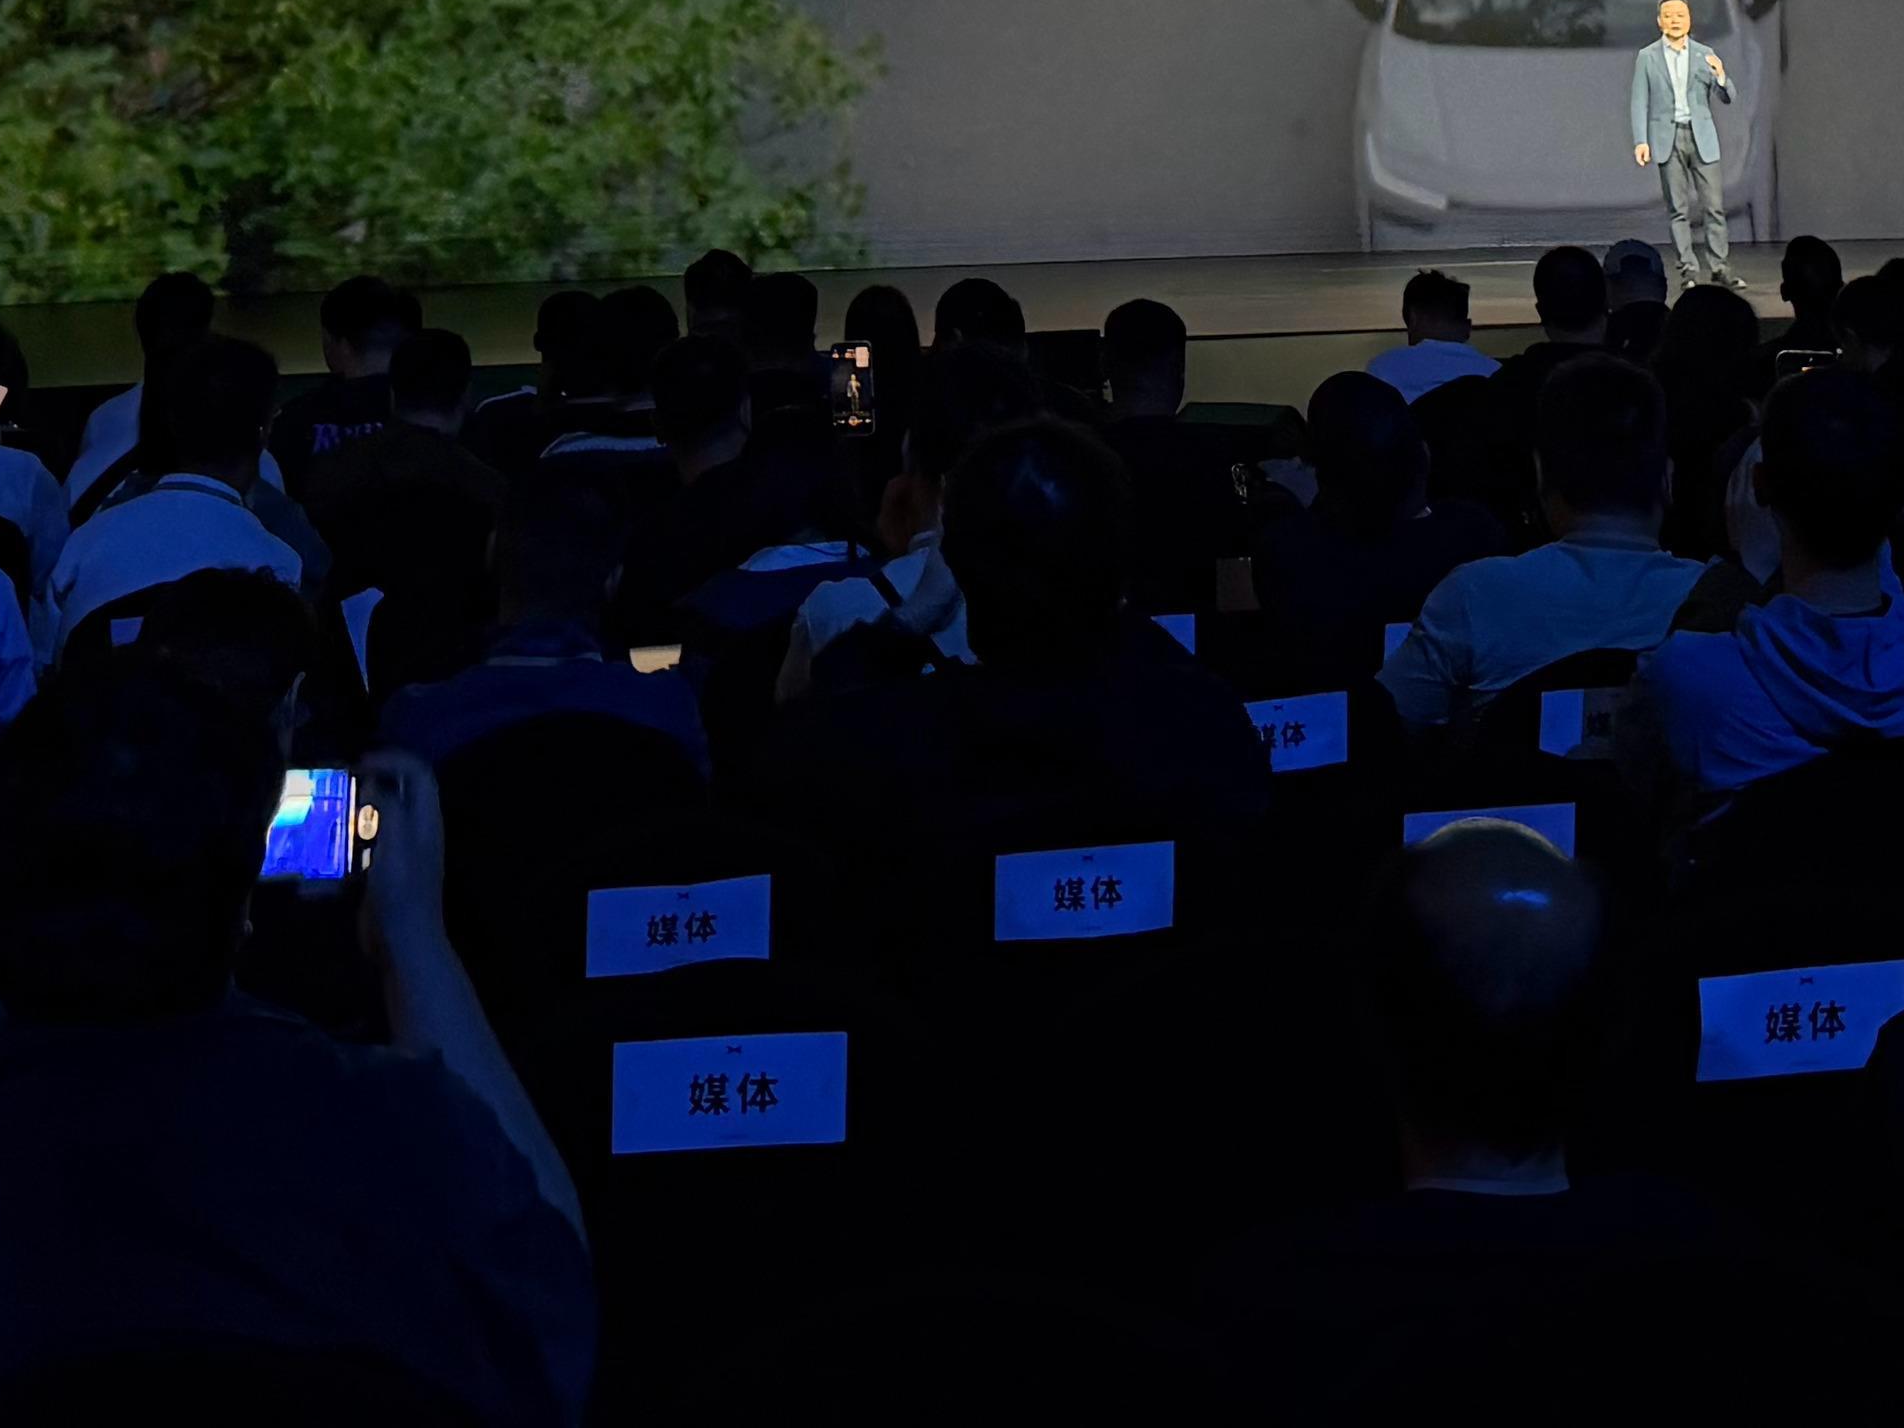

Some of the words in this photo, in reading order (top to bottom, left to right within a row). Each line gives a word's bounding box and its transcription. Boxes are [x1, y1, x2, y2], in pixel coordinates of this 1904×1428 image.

[1054, 876, 1123, 911] 媒体
[647, 911, 717, 947] 媒体
[1765, 1000, 1846, 1044] 媒体
[688, 1072, 779, 1116] 媒体
